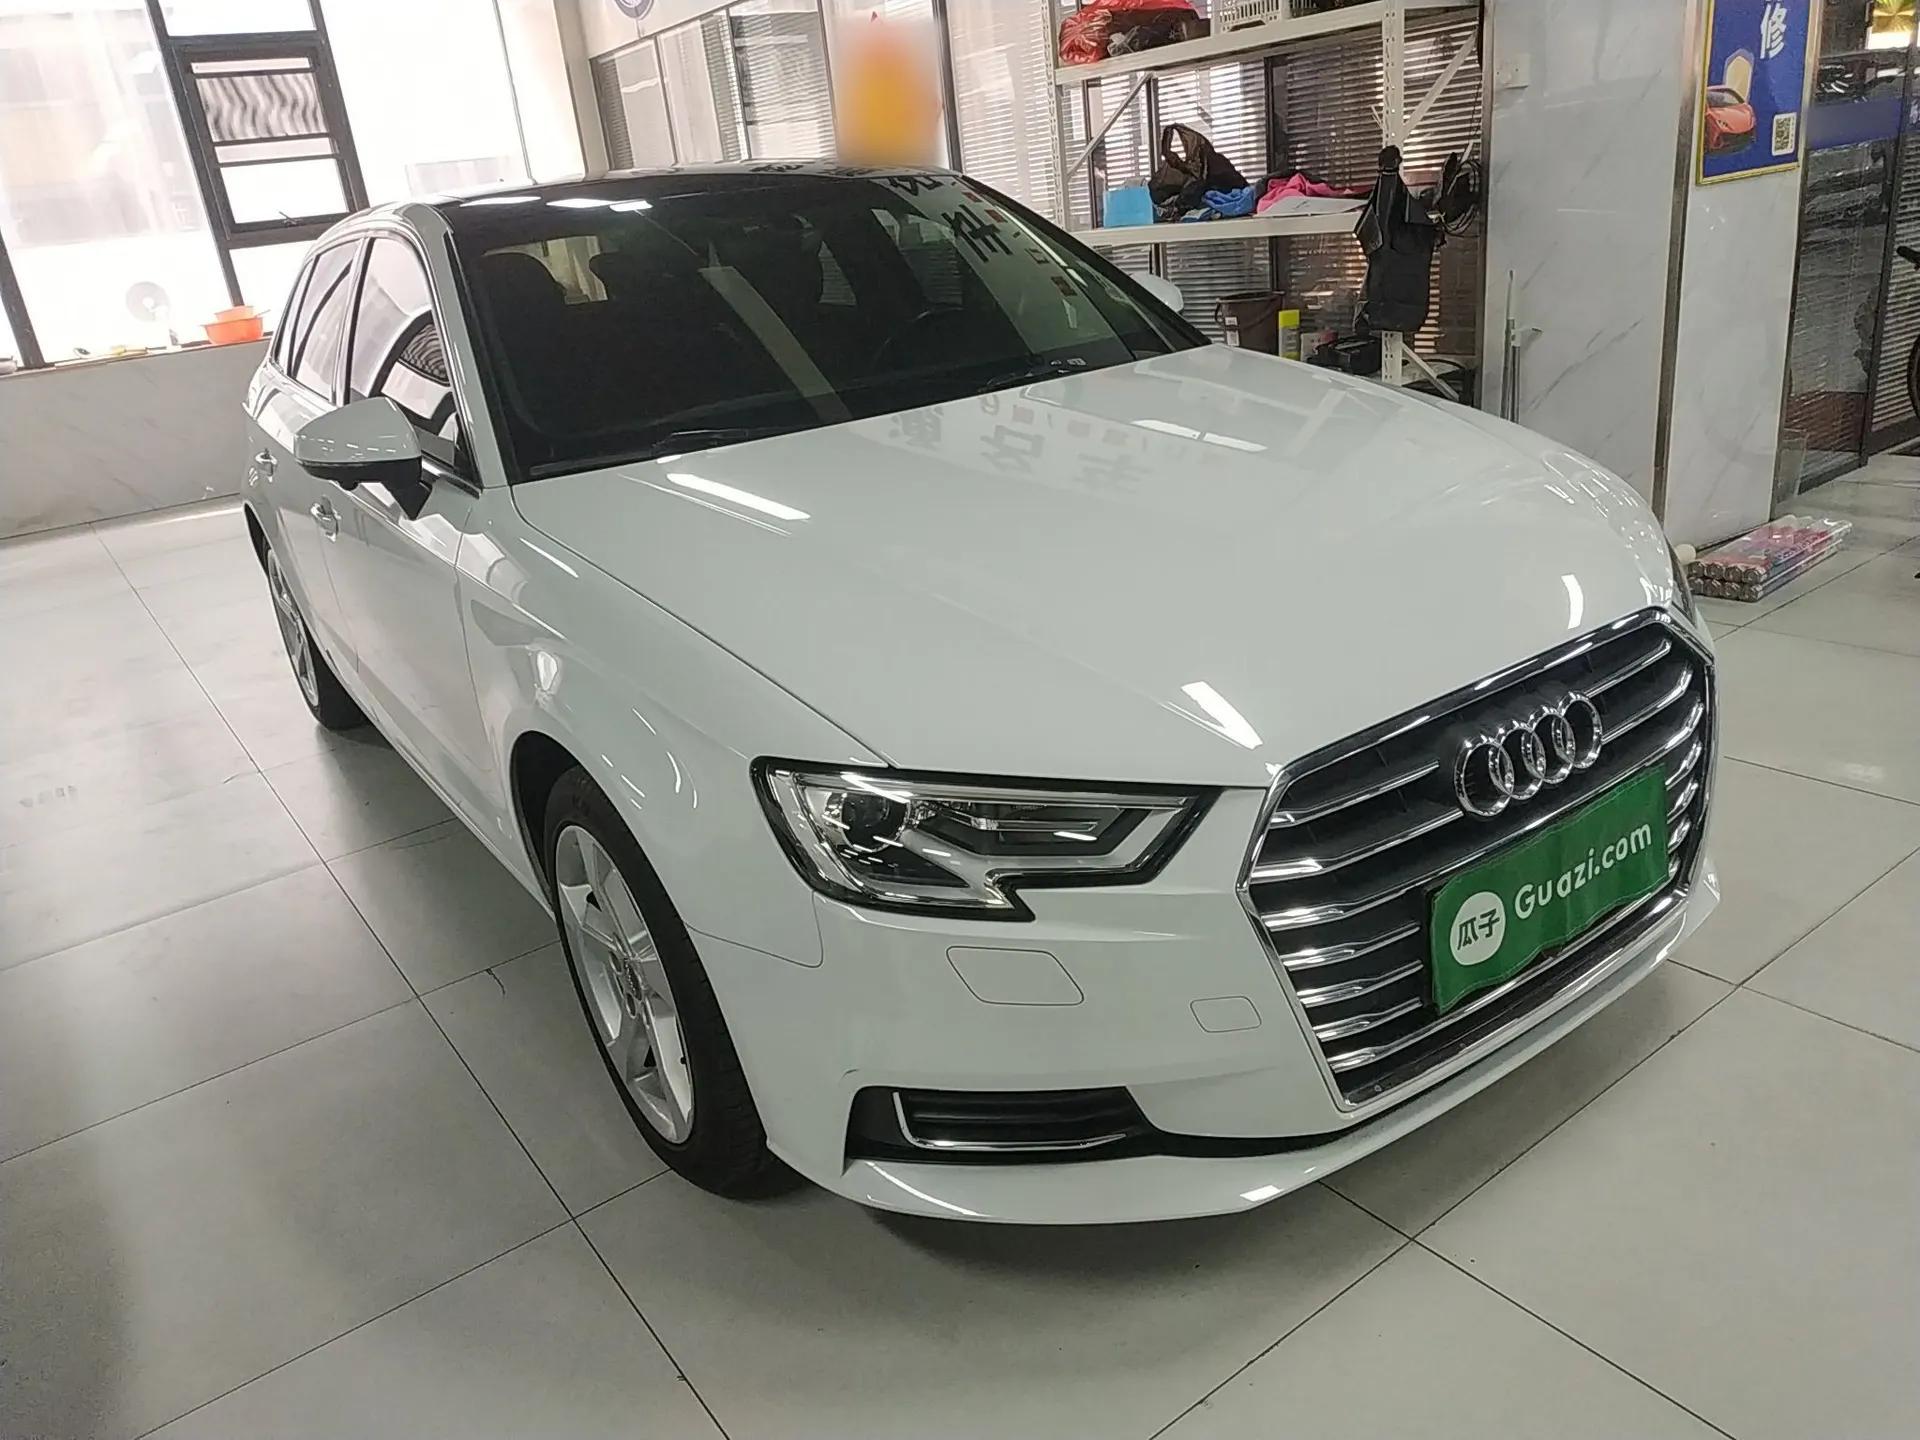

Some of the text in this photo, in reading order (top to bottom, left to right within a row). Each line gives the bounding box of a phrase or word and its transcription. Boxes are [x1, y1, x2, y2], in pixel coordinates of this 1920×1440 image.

[1759, 0, 1788, 60] 修
[1514, 823, 1652, 920] Guazi.com
[1457, 907, 1501, 951] 瓜子
